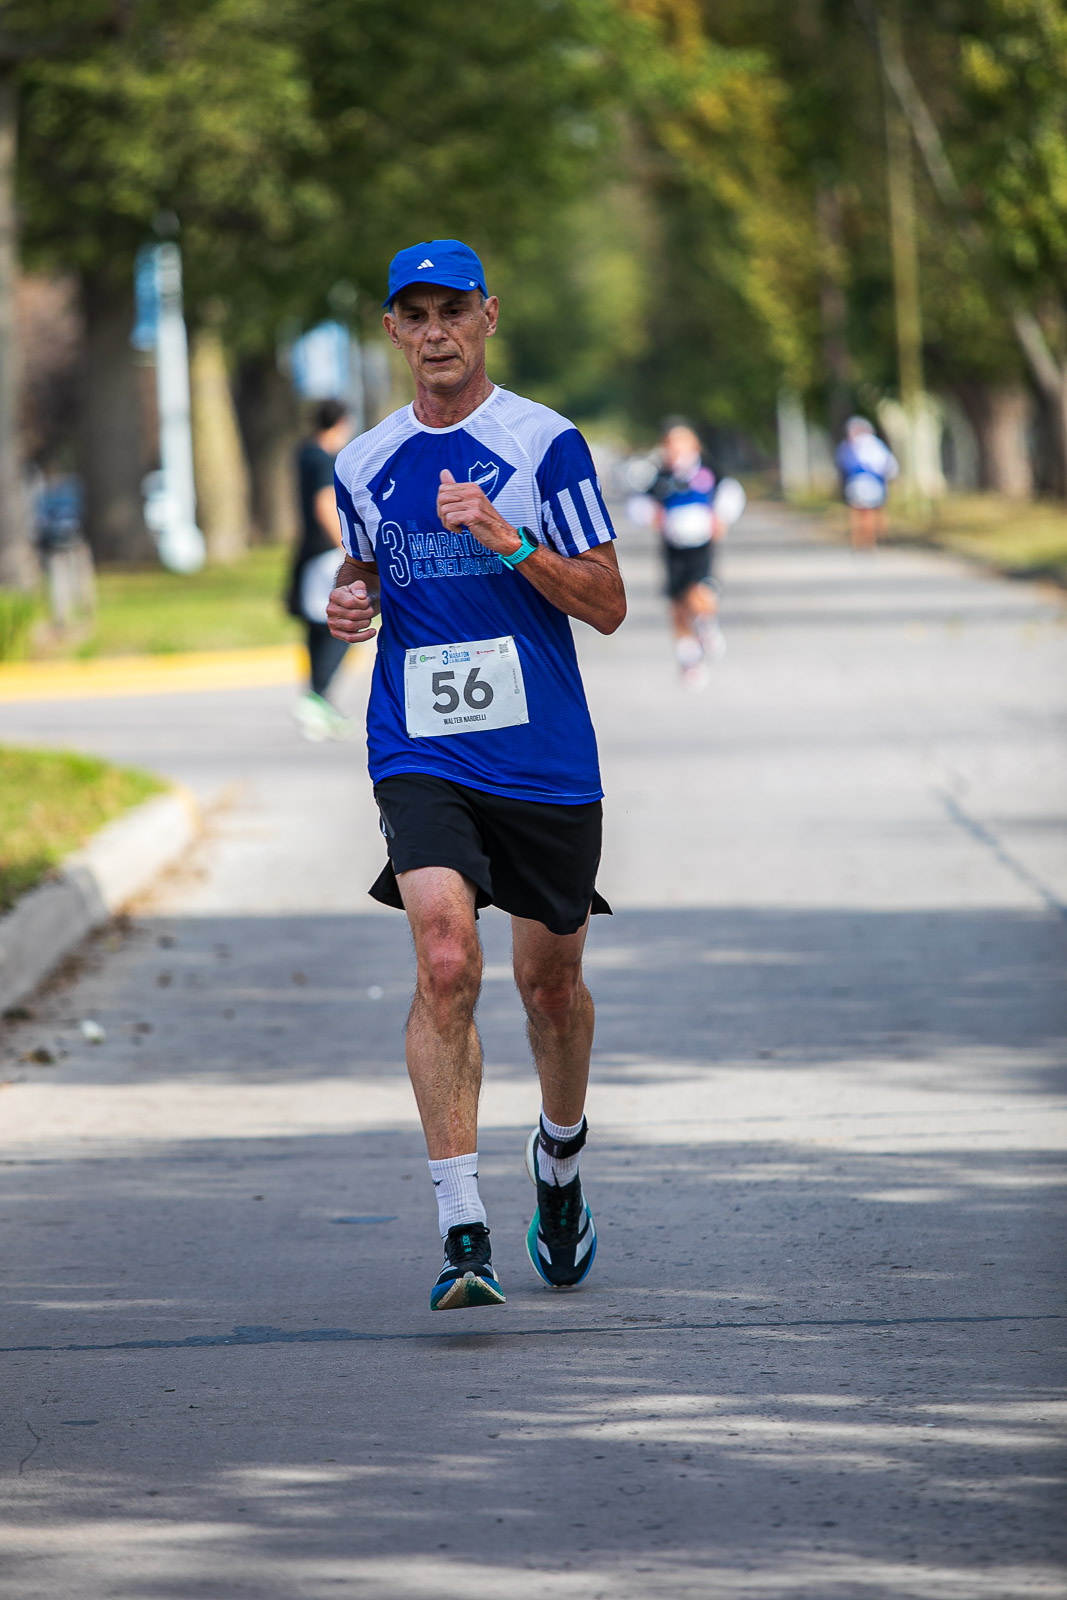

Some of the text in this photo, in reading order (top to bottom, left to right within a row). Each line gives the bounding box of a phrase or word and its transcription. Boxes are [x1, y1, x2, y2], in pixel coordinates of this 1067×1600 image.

[381, 520, 411, 587] 3
[441, 650, 449, 665] 3
[432, 667, 494, 714] 56
[443, 713, 487, 725] WALTER NARDELLI
